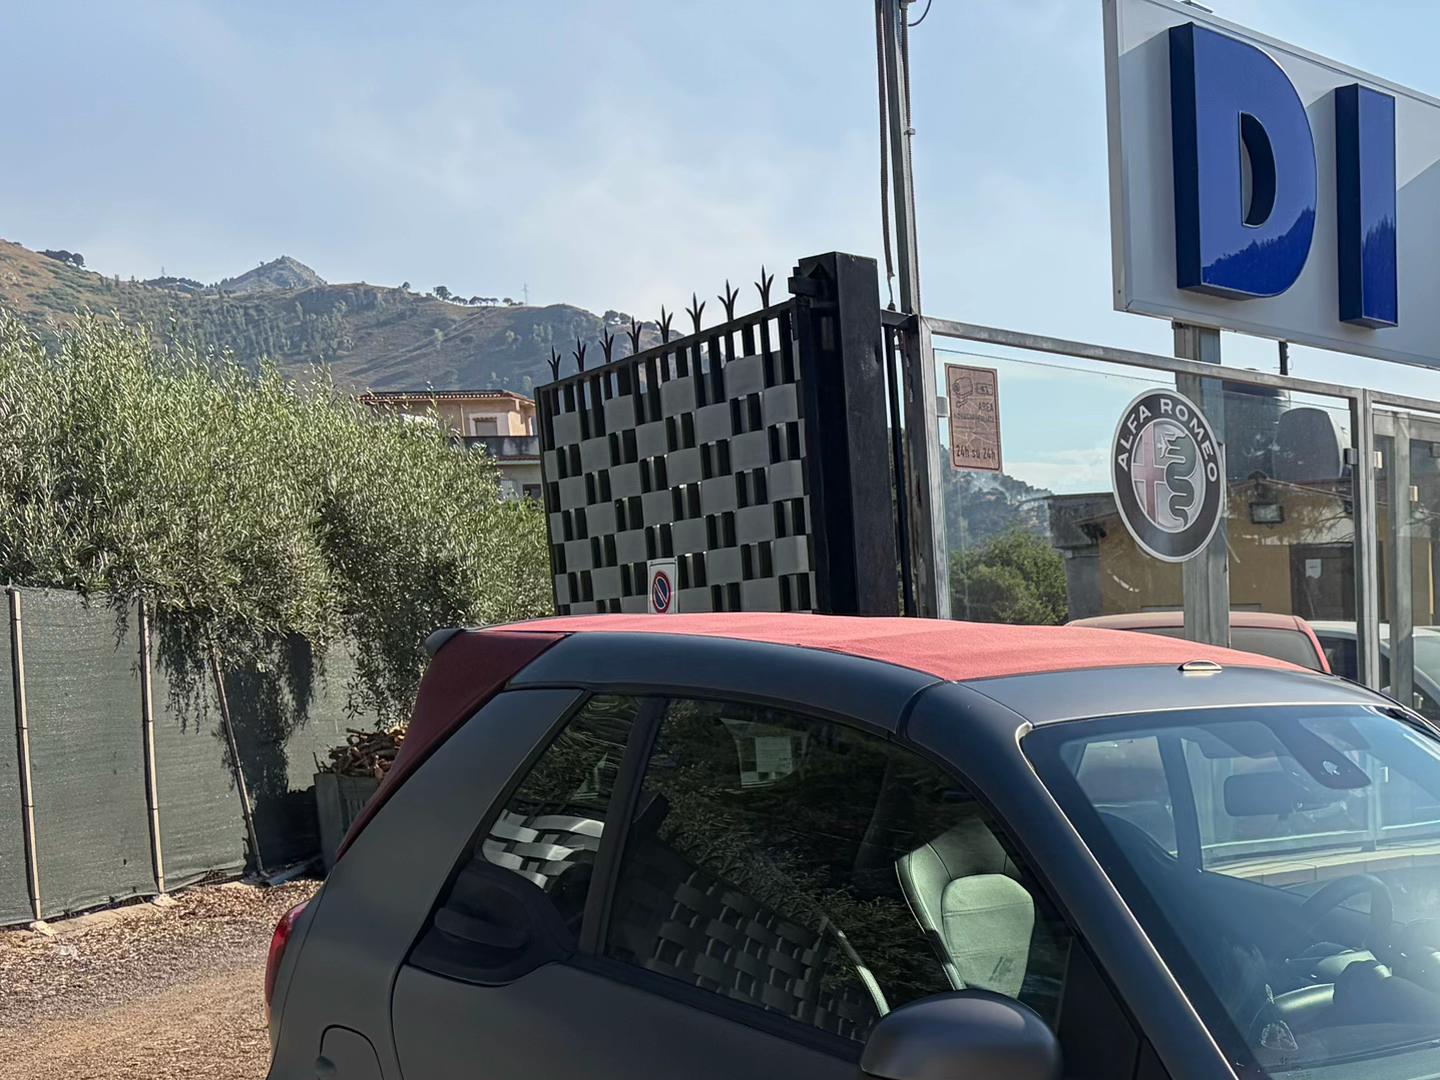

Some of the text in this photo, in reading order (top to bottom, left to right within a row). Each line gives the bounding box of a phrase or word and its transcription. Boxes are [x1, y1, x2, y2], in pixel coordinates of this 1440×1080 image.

[1169, 22, 1398, 328] DI
[1117, 398, 1218, 482] ALFA ROMEO
